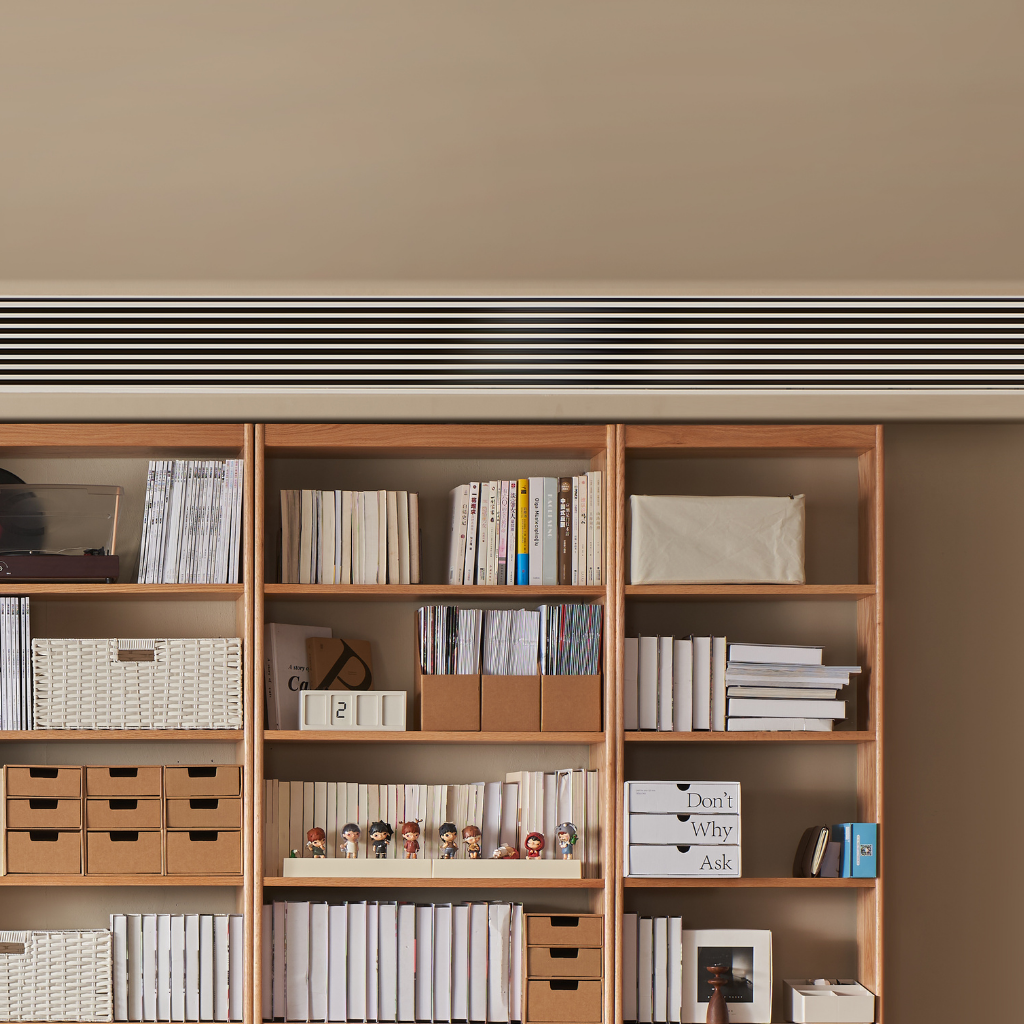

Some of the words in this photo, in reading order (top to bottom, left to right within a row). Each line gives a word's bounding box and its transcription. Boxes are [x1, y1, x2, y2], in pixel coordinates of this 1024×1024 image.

[336, 701, 346, 718] 2
[687, 792, 733, 808] Don't
[691, 821, 733, 842] Why
[700, 854, 732, 870] Ask
